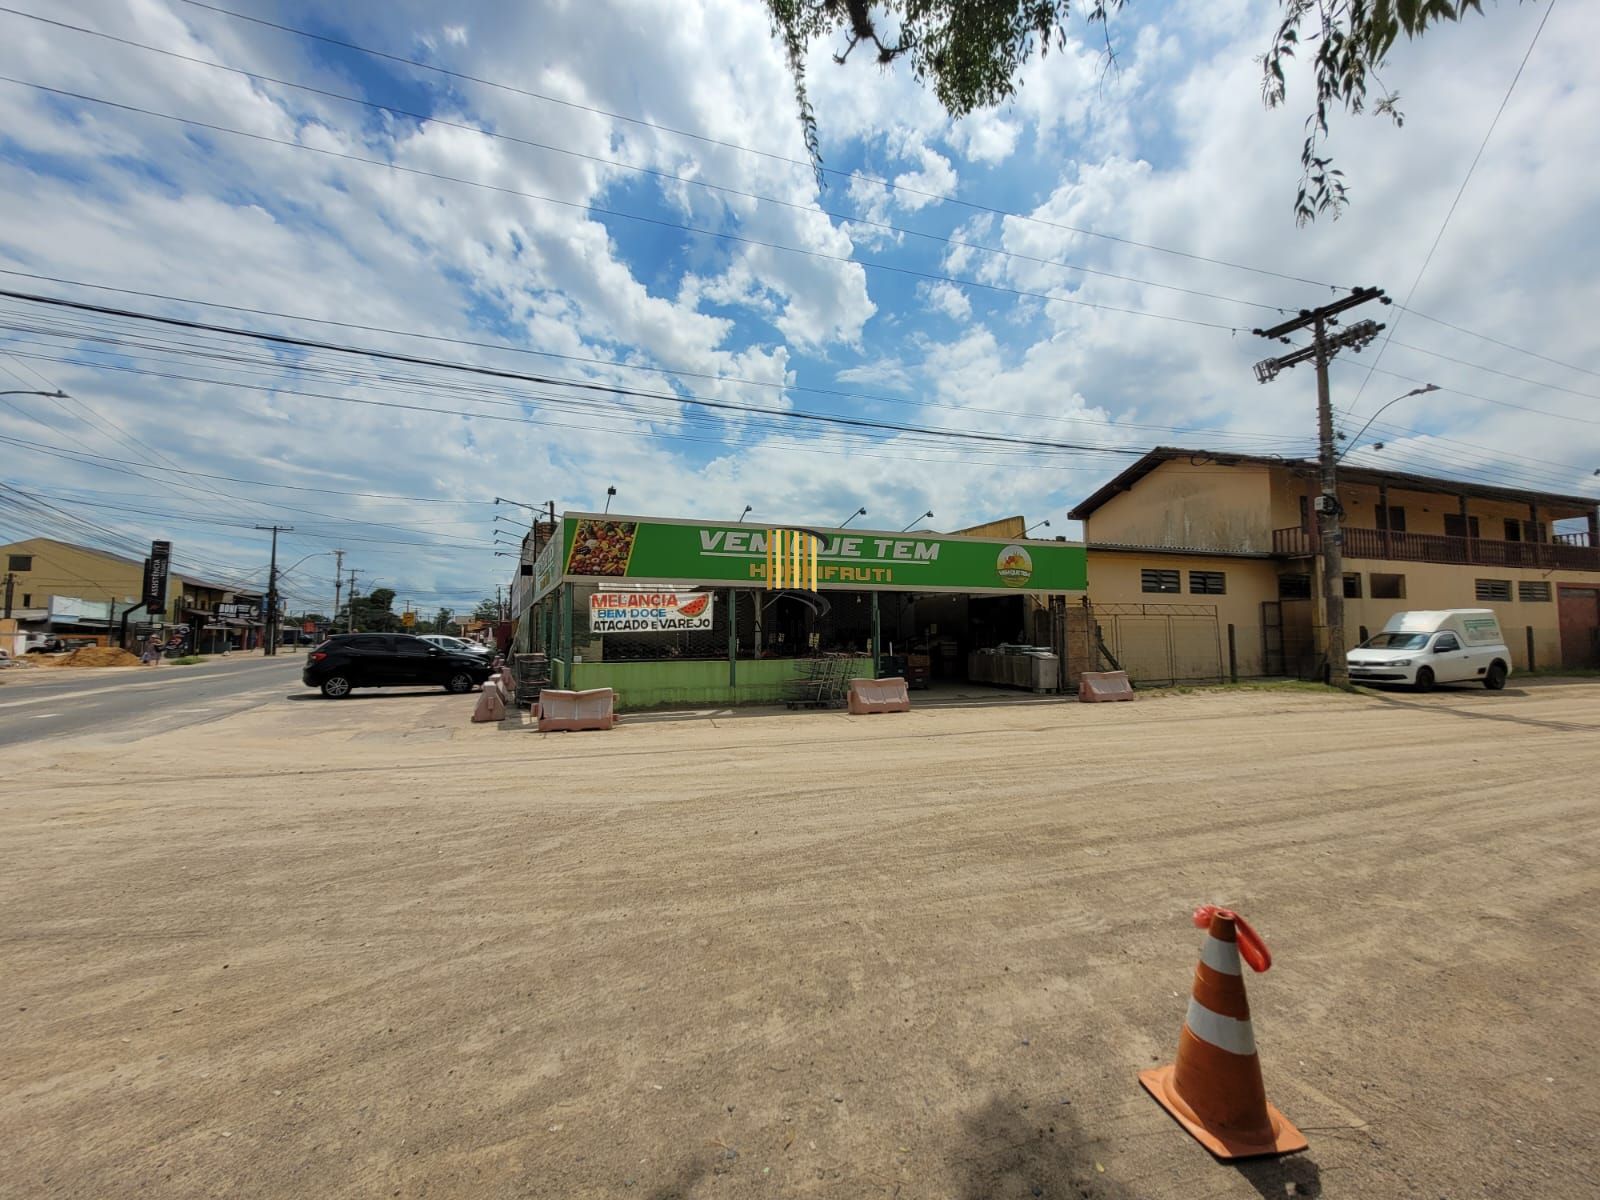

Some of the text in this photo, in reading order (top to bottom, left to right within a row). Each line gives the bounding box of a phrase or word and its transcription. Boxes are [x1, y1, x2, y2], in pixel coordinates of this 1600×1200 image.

[700, 530, 780, 553] VEM
[874, 539, 940, 561] TEM
[750, 564, 892, 582] HIFRUTI
[591, 594, 678, 608] MELANCIA
[597, 609, 667, 618] BEM DOCE
[594, 619, 710, 631] ATACADO E VAREJO
